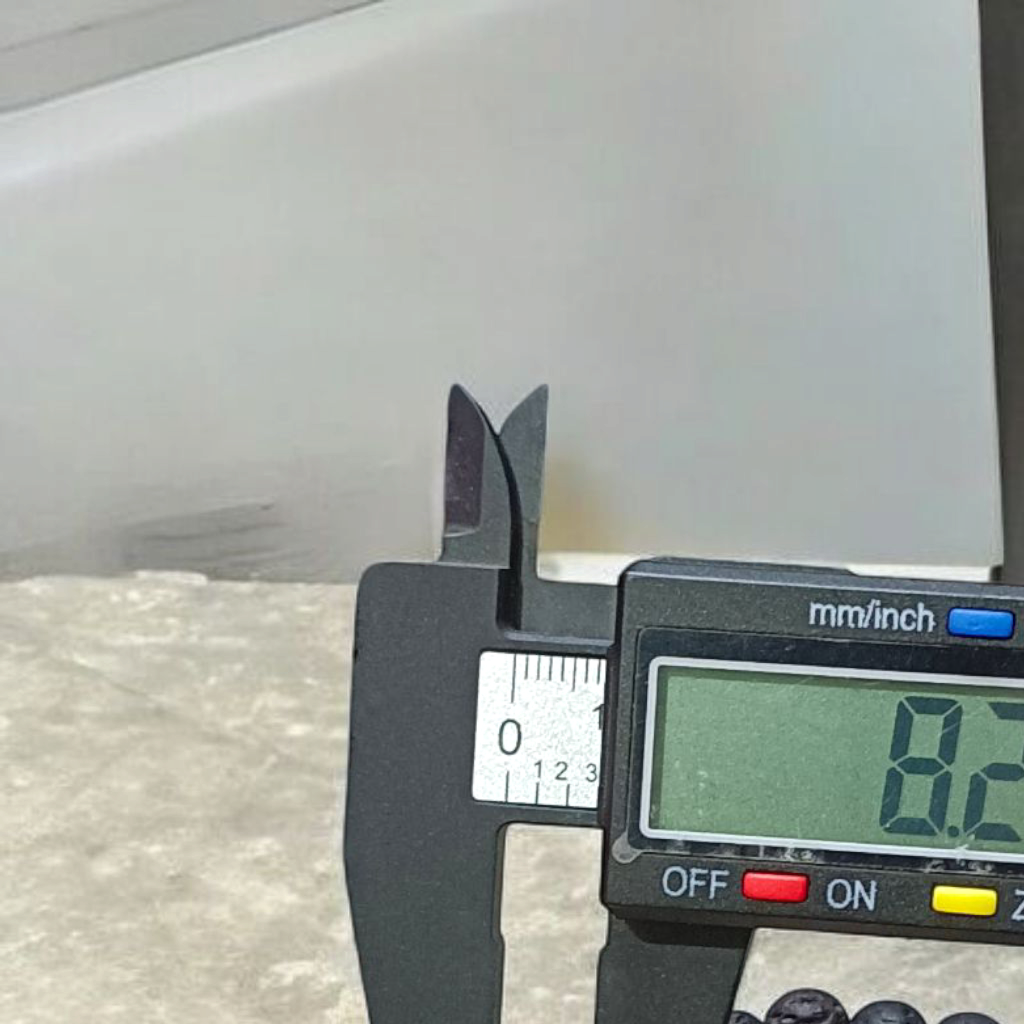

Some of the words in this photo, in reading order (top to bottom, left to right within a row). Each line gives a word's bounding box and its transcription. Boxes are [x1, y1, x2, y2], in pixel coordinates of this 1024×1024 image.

[808, 599, 936, 633] mm/inch
[498, 719, 521, 755] 0
[661, 866, 728, 899] OFF
[826, 878, 877, 911] ON
